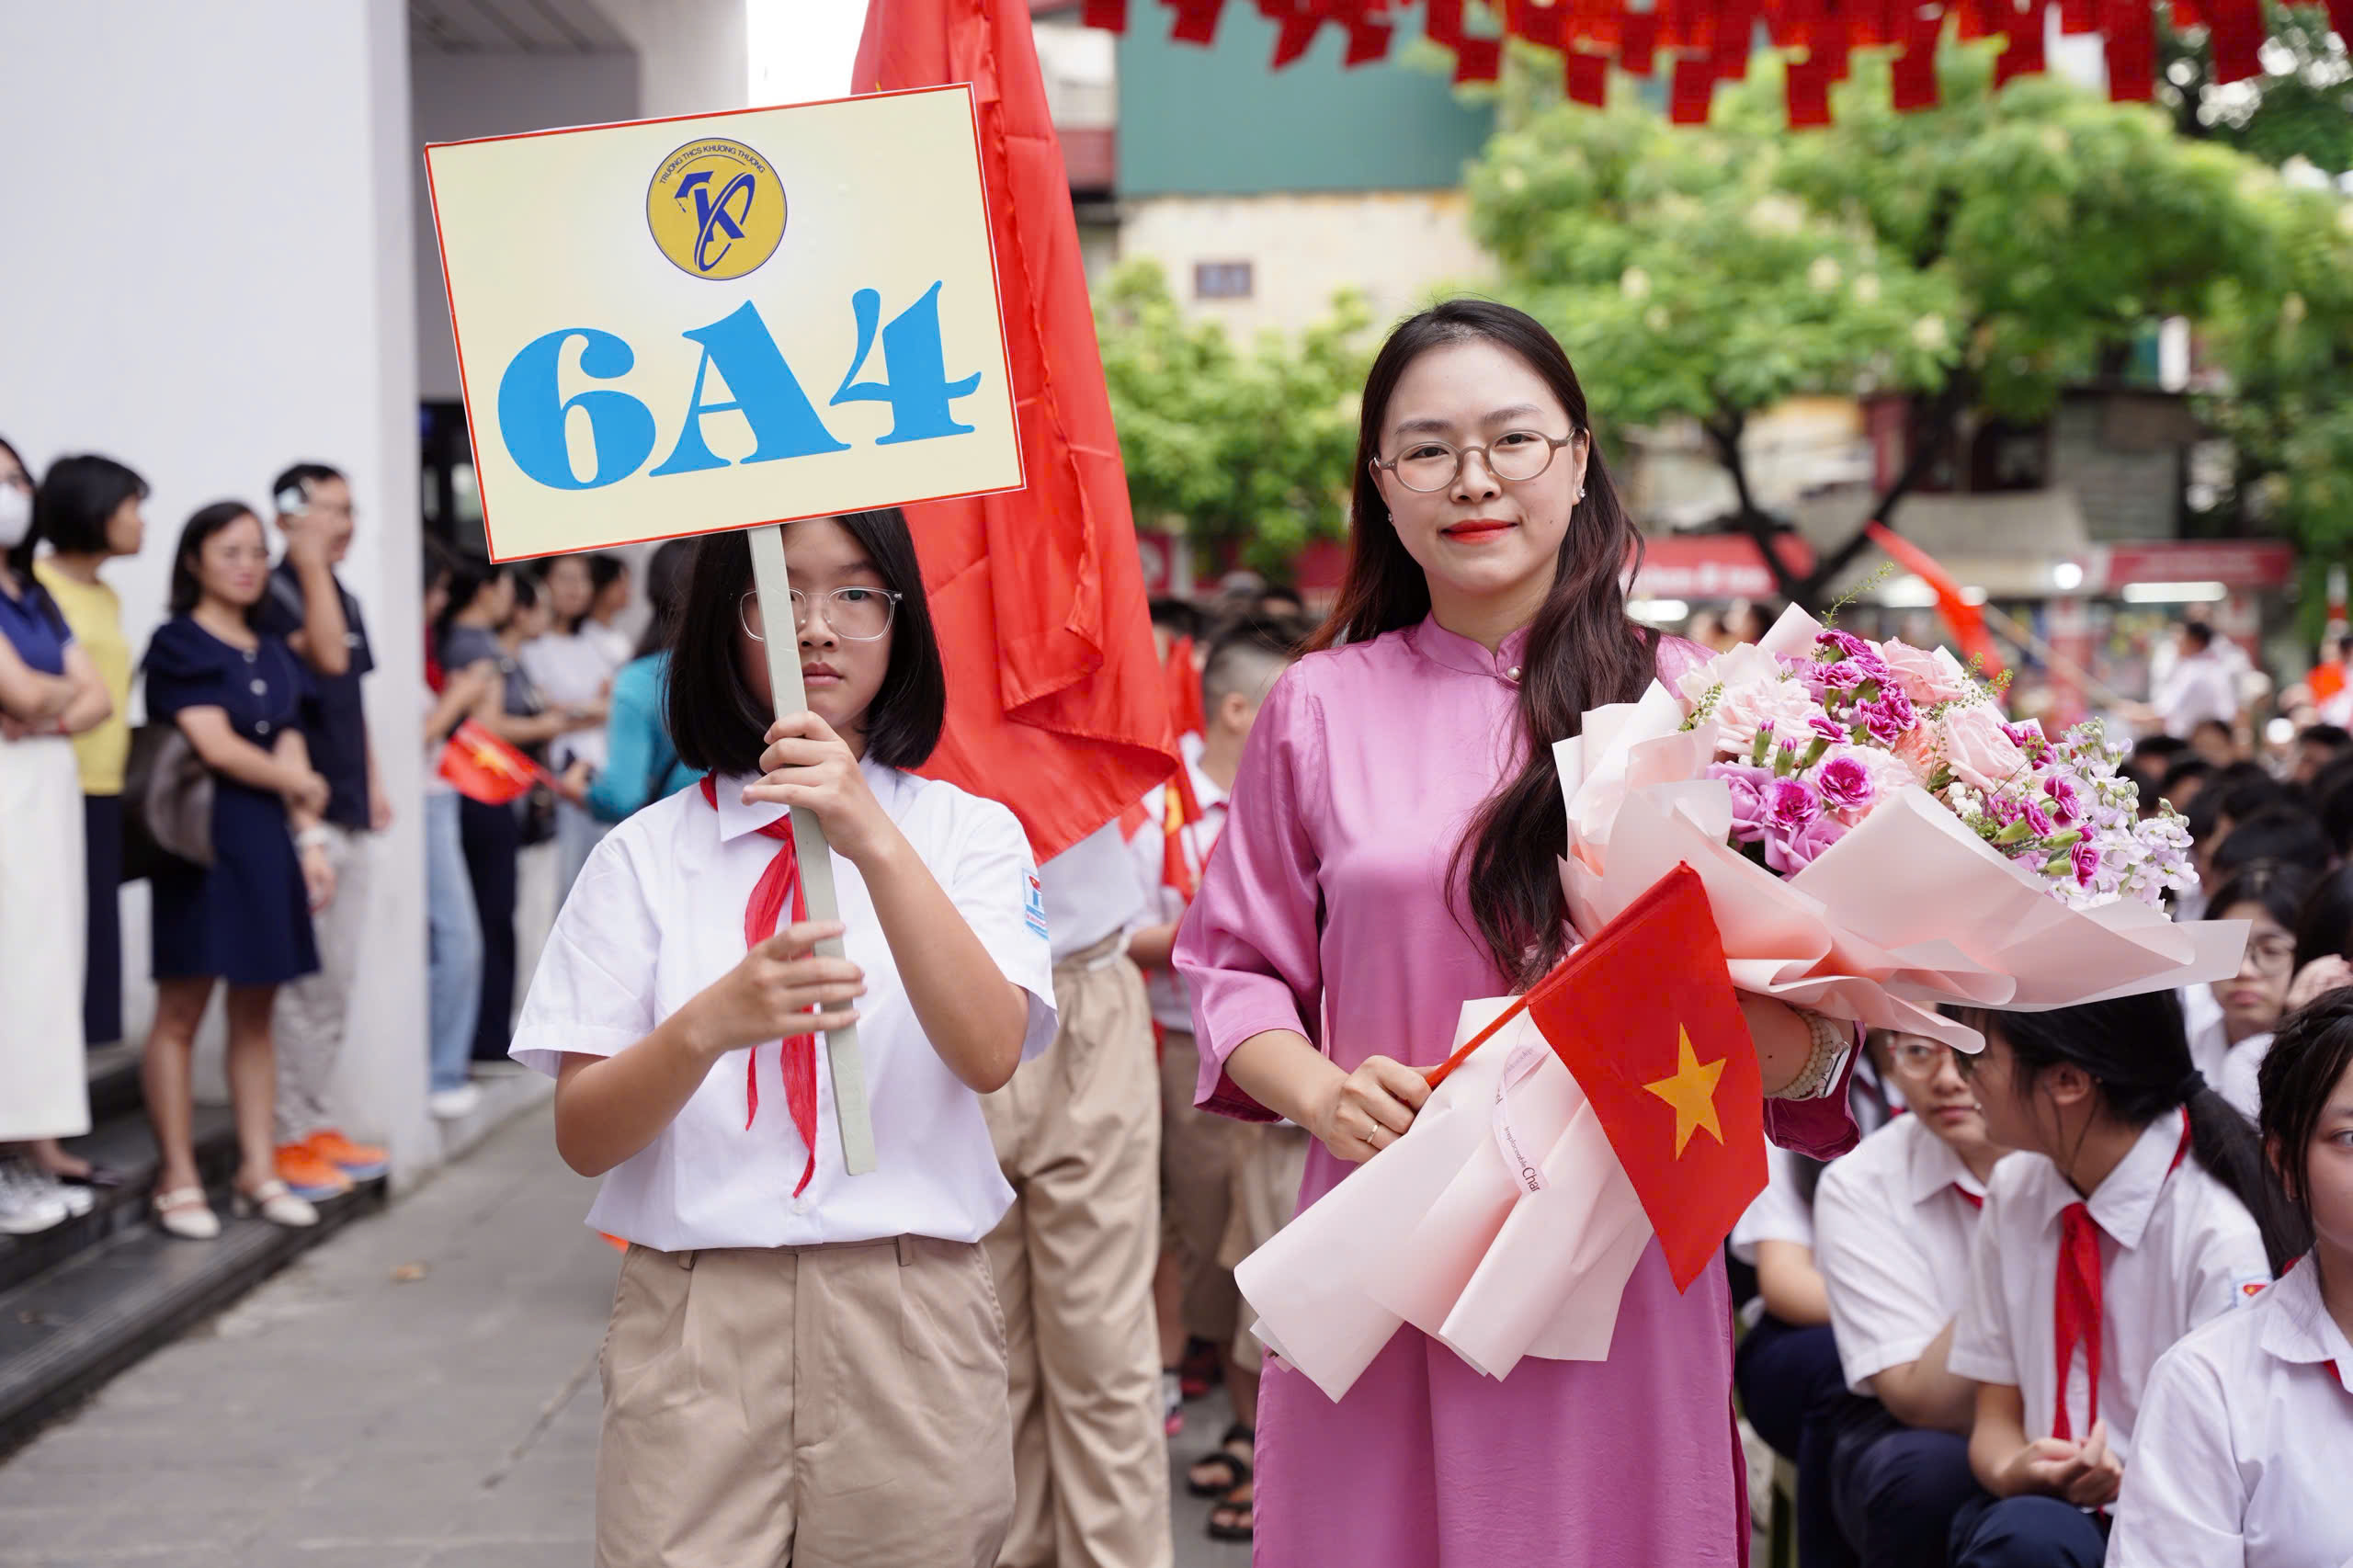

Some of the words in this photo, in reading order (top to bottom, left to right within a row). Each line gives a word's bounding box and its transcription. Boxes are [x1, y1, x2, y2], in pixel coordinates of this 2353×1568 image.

[682, 147, 702, 158] THCS
[703, 144, 736, 154] KHƯƠNG
[497, 279, 983, 491] 6A4
